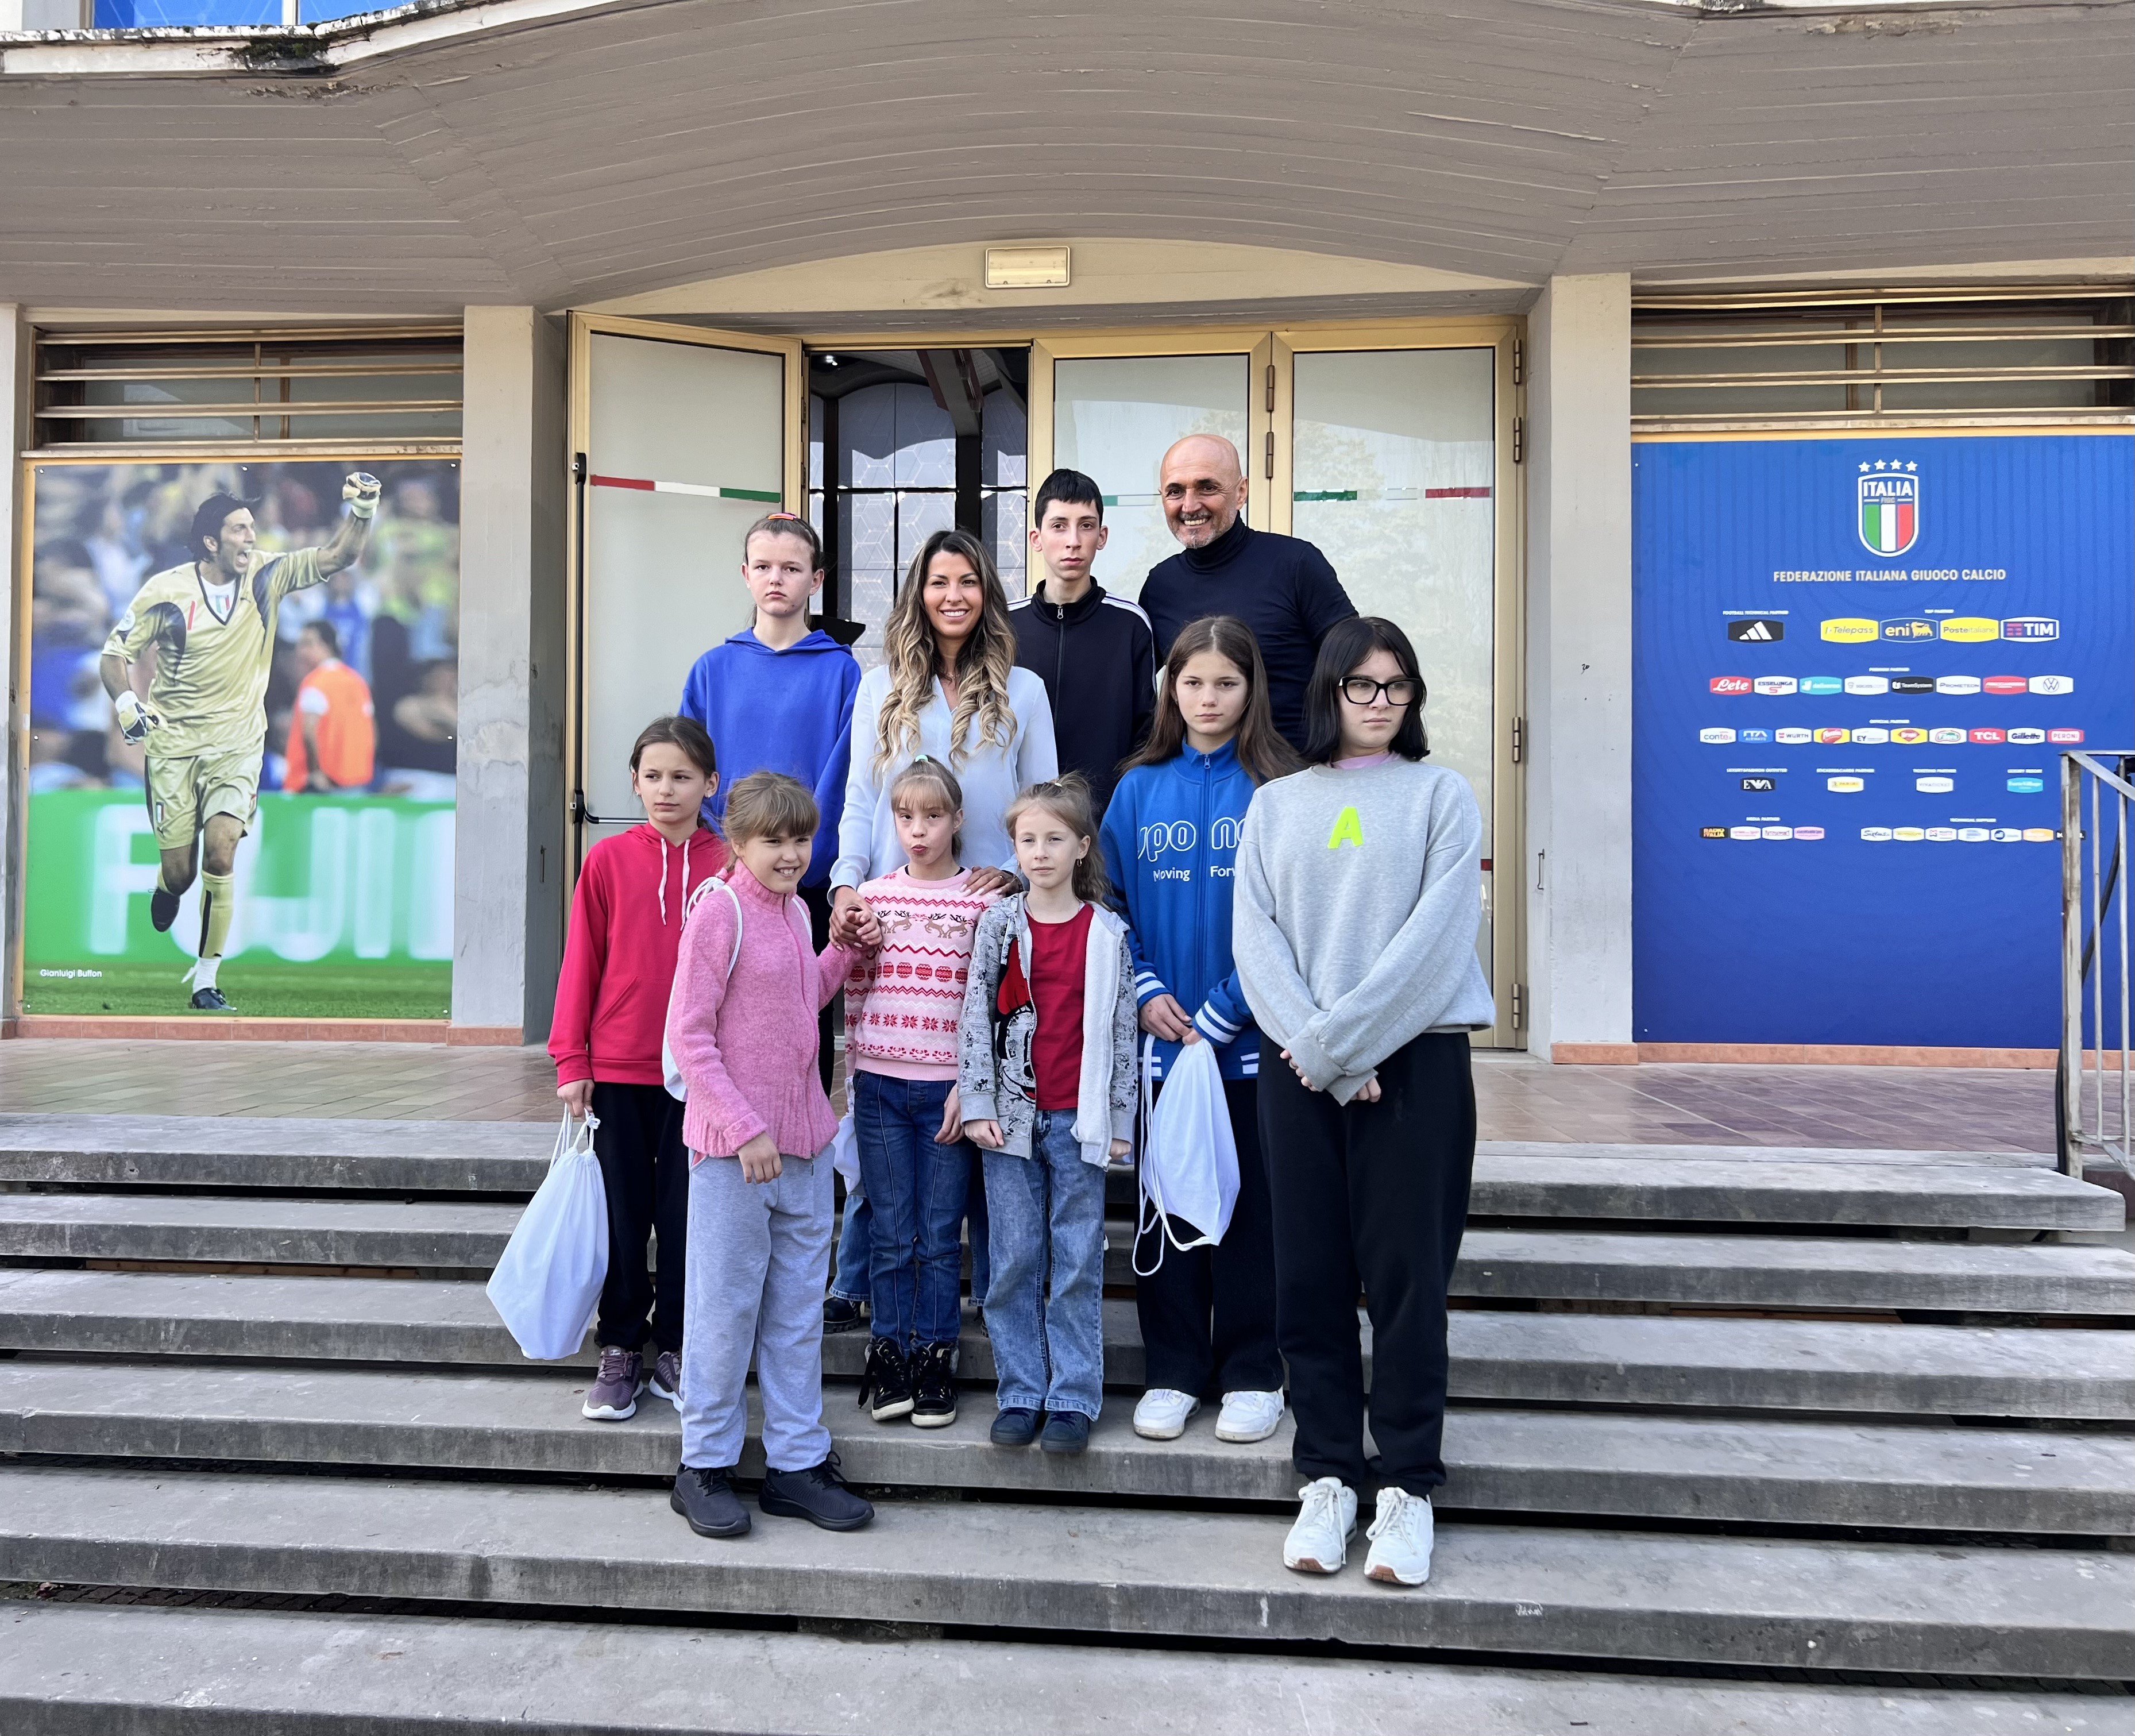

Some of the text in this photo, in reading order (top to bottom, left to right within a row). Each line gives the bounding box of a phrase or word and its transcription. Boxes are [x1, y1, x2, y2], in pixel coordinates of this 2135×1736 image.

[1863, 481, 1913, 497] ITALIA
[1773, 569, 2006, 582] FEDERAZIONE ITALIANA GIUOCO CALCIO
[1833, 626, 1874, 635] Telepass
[1885, 623, 1910, 636] eni
[2024, 623, 2053, 636] TIM
[1713, 678, 1750, 692] Lete
[1974, 731, 2000, 740] TCL
[1327, 806, 1364, 849] A
[1153, 867, 1191, 882] Moving
[40, 969, 76, 979] Gianluigi
